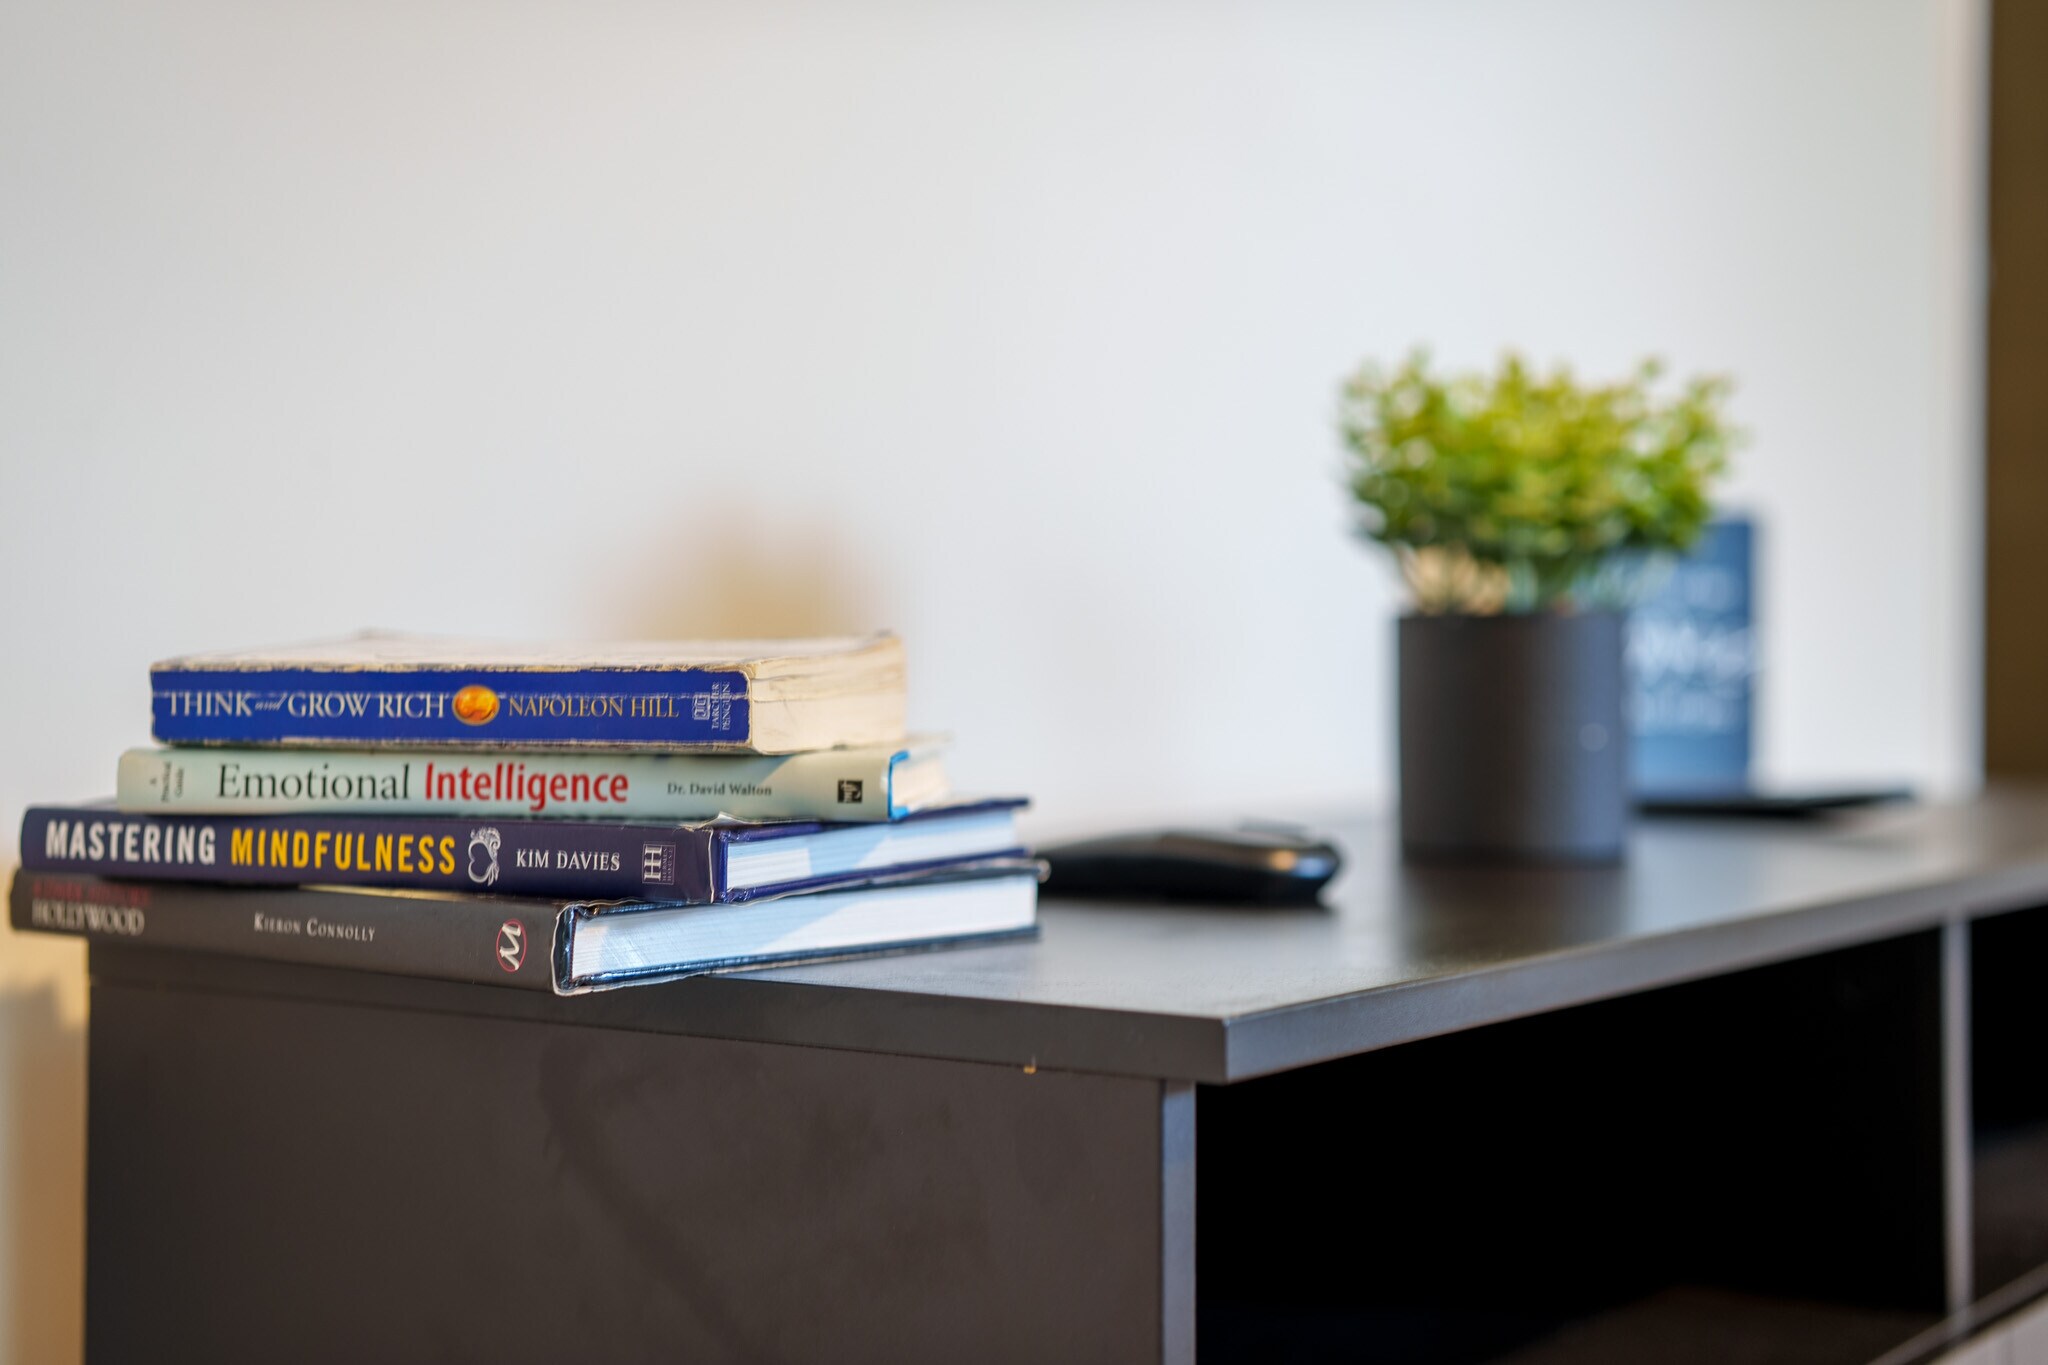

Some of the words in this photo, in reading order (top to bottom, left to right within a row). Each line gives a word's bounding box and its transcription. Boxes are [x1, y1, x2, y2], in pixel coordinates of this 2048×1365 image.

[169, 691, 253, 717] THINK
[254, 692, 286, 711] and
[287, 691, 370, 718] GROW
[377, 691, 445, 718] RICH
[508, 696, 624, 718] NAPOLEON
[630, 696, 680, 718] HILL
[711, 682, 720, 729] TARCHER
[722, 682, 731, 731] PENGUIN
[217, 763, 410, 800] Emotional
[424, 762, 629, 812] Intelligence
[666, 782, 686, 796] Dr.
[689, 782, 726, 797] David
[728, 783, 772, 798] Walton
[45, 820, 216, 865] MASTERING
[231, 827, 456, 875] MINDFULNESS
[516, 848, 550, 868] KIM
[556, 851, 621, 872] DAVIES
[31, 899, 145, 936] HOLLYWOOD
